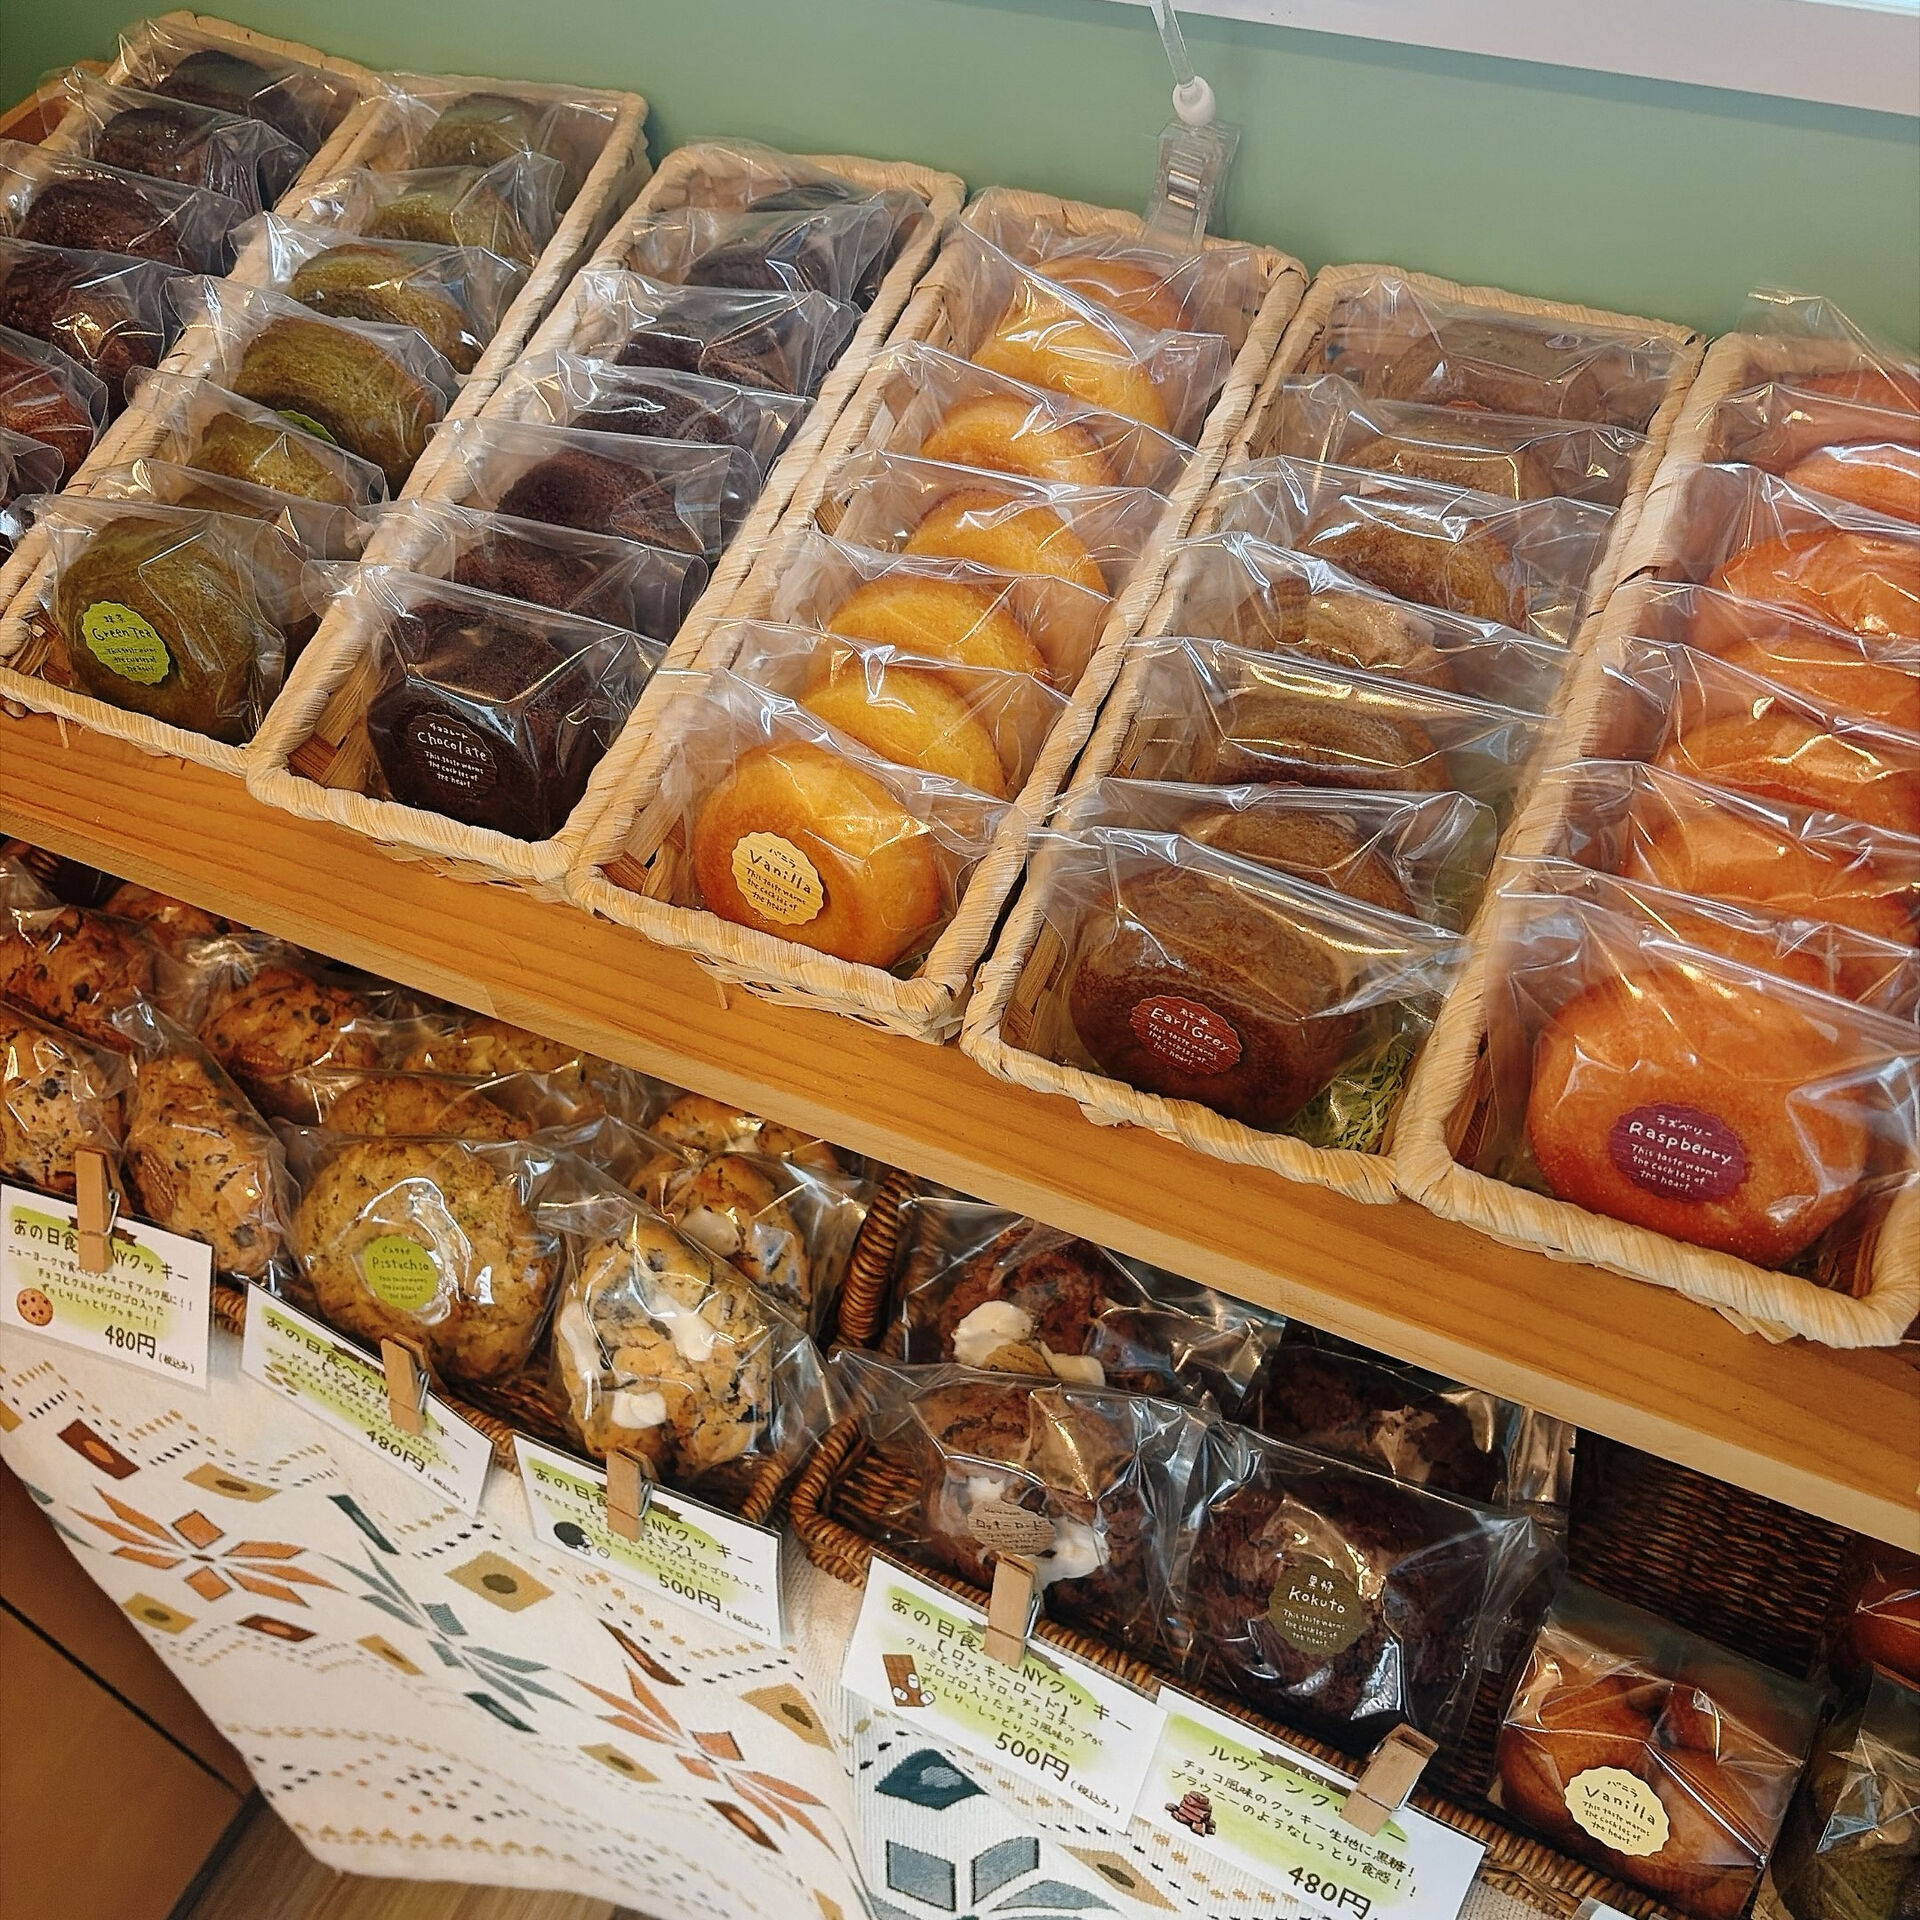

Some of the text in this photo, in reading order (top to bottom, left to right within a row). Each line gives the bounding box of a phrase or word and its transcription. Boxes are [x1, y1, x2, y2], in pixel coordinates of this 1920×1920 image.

[92, 627, 152, 641] Green Tea
[417, 732, 486, 761] Chocolate
[750, 850, 811, 894] Vanilla
[769, 849, 796, 868] バニラ
[1151, 1007, 1229, 1051] Earl Grey
[1629, 1121, 1732, 1165] Raspberry
[1656, 1114, 1712, 1137] ラズベリー
[1631, 1144, 1718, 1178] This taste warms
[1639, 1170, 1656, 1180] the
[1694, 1177, 1705, 1185] of
[372, 1257, 429, 1271] Pistachio
[105, 1325, 156, 1359] 480円
[366, 1430, 426, 1473] 480円
[976, 1519, 1045, 1530] ロッキーロード
[658, 1573, 721, 1613] 500円
[1288, 1586, 1345, 1614] Kokuto
[906, 1637, 1104, 1746] クルミとマシュマロ、チョコチップが
[937, 1639, 1069, 1717] 【ロッキーロード】
[920, 1675, 1070, 1757] ずっしり、しっとりクッキー
[924, 1661, 1075, 1747] ゴロゴロ入ったチョコ風味の
[995, 1732, 1070, 1781] 500円
[1584, 1785, 1656, 1825] Vanilla
[1607, 1781, 1637, 1798] バニラ
[1170, 1769, 1417, 1897] ブラウニーのようなしっとり食感！！
[1183, 1758, 1415, 1877] チョコ風味のクッキー生地に黒糖！
[1583, 1801, 1650, 1836] This taste warms
[1592, 1821, 1605, 1831] the
[1288, 1867, 1371, 1920] 480円
